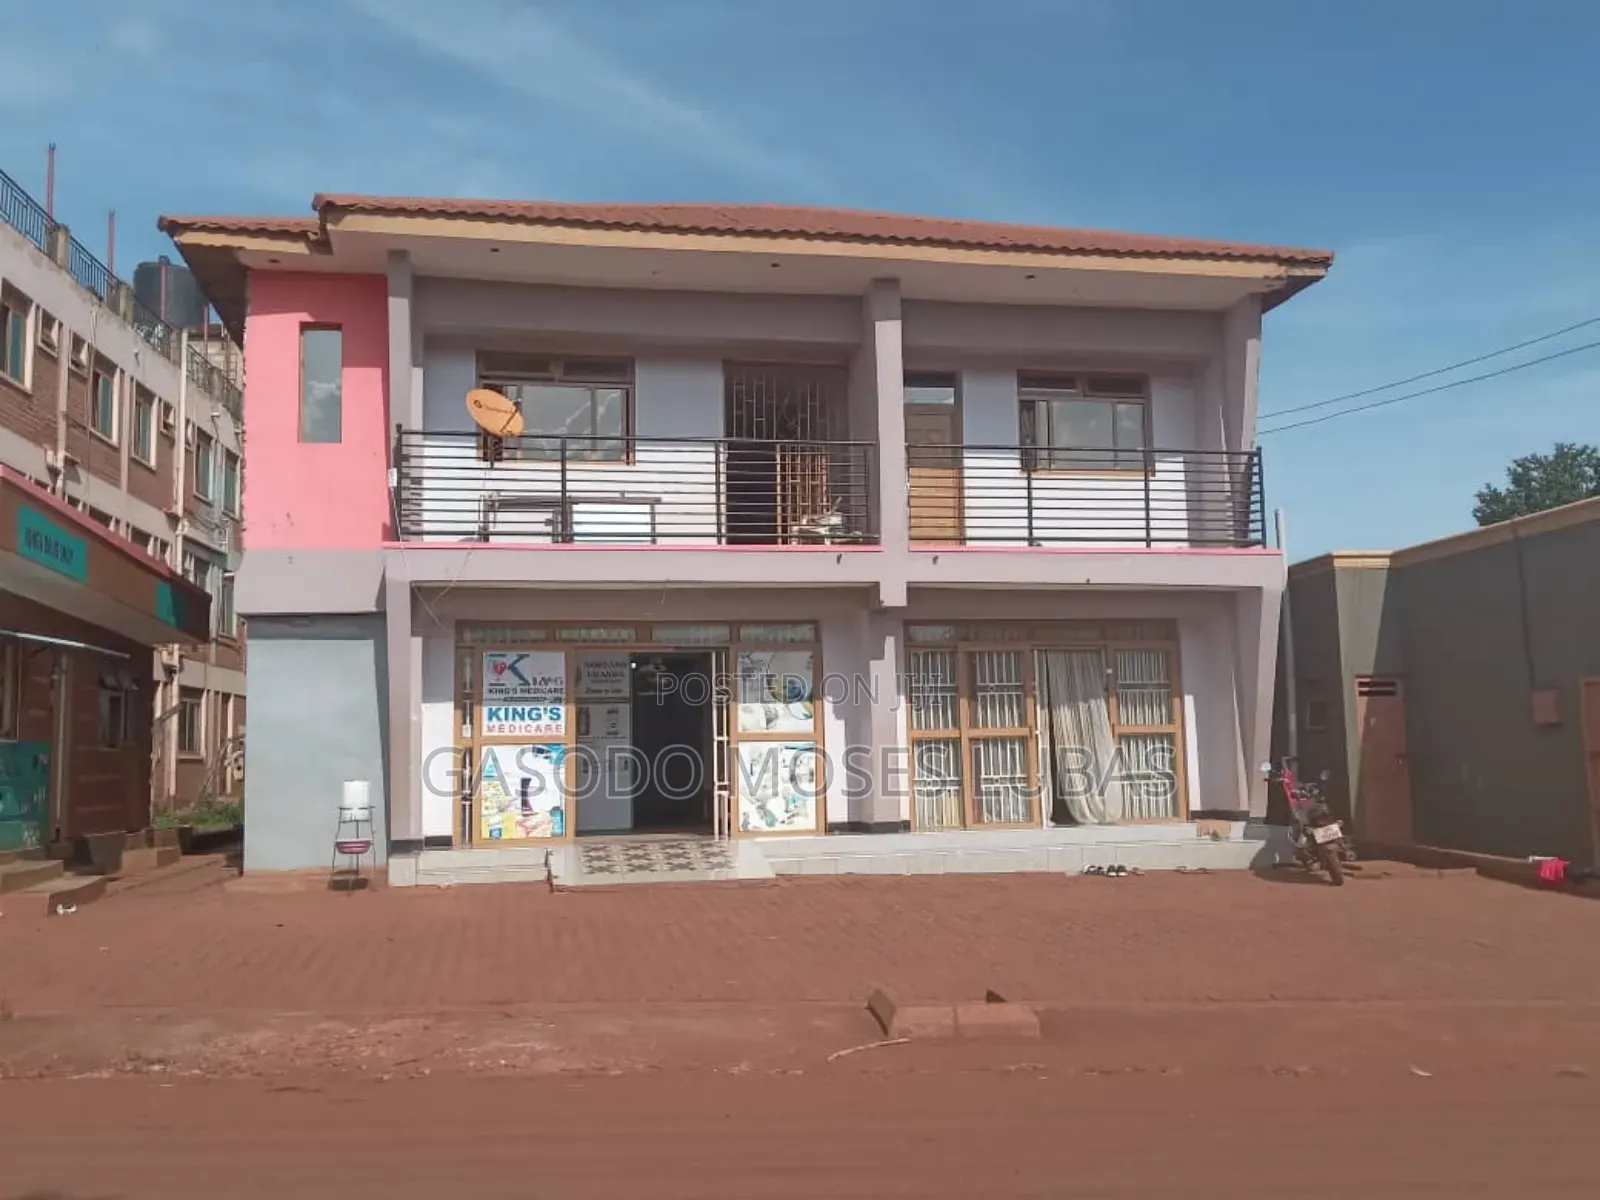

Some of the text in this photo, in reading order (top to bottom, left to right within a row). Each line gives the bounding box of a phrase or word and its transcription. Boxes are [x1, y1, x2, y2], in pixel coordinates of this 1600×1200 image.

[519, 687, 564, 695] MEDICARE
[487, 707, 562, 722] KING'S
[486, 724, 563, 733] MEDICARE
